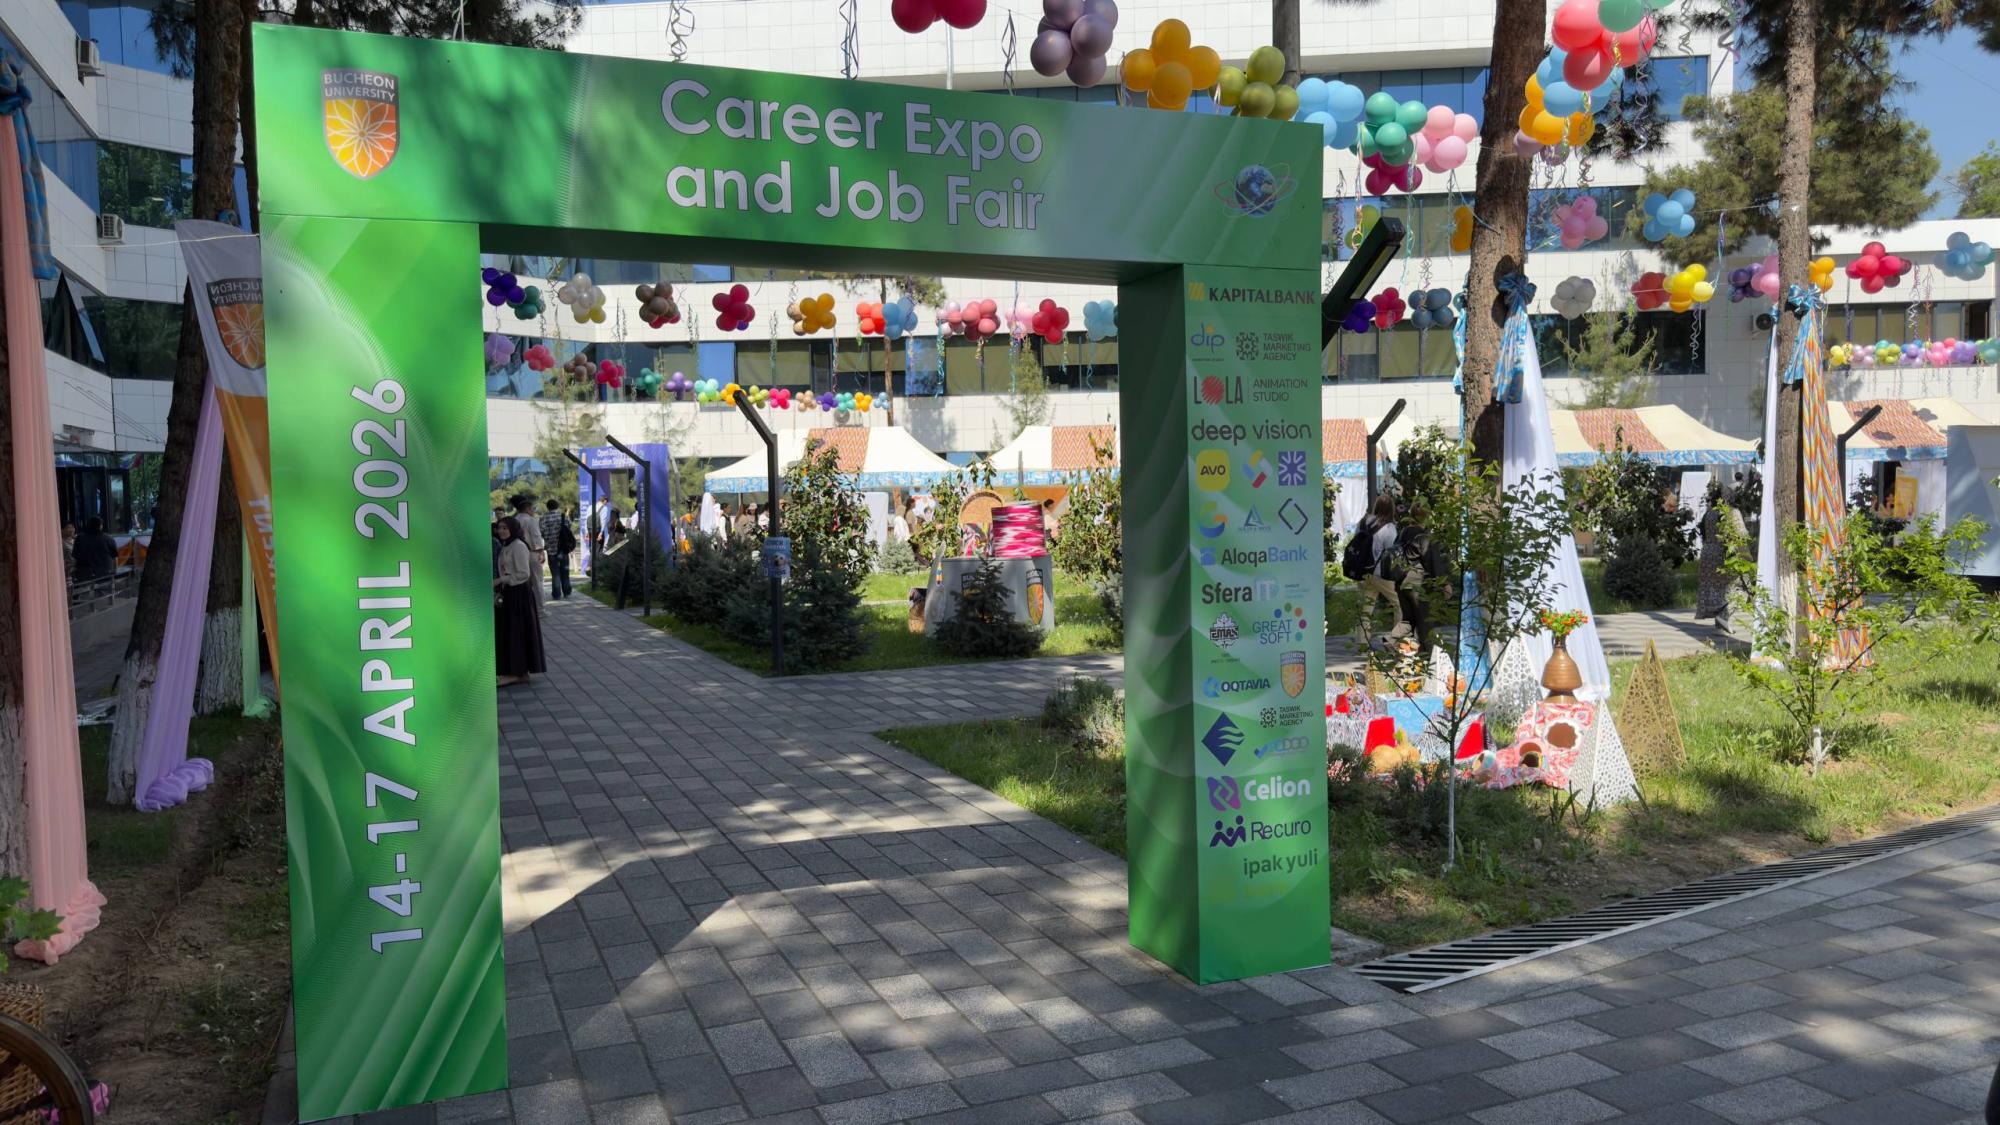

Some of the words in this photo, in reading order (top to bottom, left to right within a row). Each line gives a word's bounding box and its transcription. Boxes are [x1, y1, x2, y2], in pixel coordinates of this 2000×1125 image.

[323, 72, 395, 90] BUCHEON
[325, 86, 396, 102] UNIVERSITY
[660, 79, 884, 150] Career
[904, 101, 1043, 172] Expo
[665, 160, 794, 214] and
[815, 165, 925, 223] Job
[946, 175, 1045, 230] Fair
[1209, 287, 1316, 304] KAPITALBANK
[1191, 321, 1225, 354] dip
[1263, 333, 1294, 341] TASWIK
[1263, 343, 1312, 351] MARKETING
[1263, 353, 1297, 361] AGENCY
[1252, 378, 1308, 389] ANIMATION
[1252, 391, 1290, 402] STUDIO
[1191, 419, 1247, 446] deep
[1253, 419, 1312, 440] vision
[350, 379, 409, 540] 2026
[1200, 464, 1226, 476] AVO
[1221, 545, 1308, 568] AloqaBank
[1202, 582, 1253, 605] Sfera
[1253, 619, 1293, 633] GREAT
[1259, 632, 1291, 645] SOFT
[356, 561, 416, 746] APRIL
[1221, 677, 1271, 693] OQTAVIA
[1279, 711, 1314, 720] MARKETING
[1279, 719, 1304, 727] AGENCY
[1244, 776, 1311, 802] Celion
[1250, 819, 1312, 841] Recuro
[365, 772, 424, 955] 14-17
[1243, 855, 1283, 879] ipak
[1286, 848, 1318, 873] yuli
